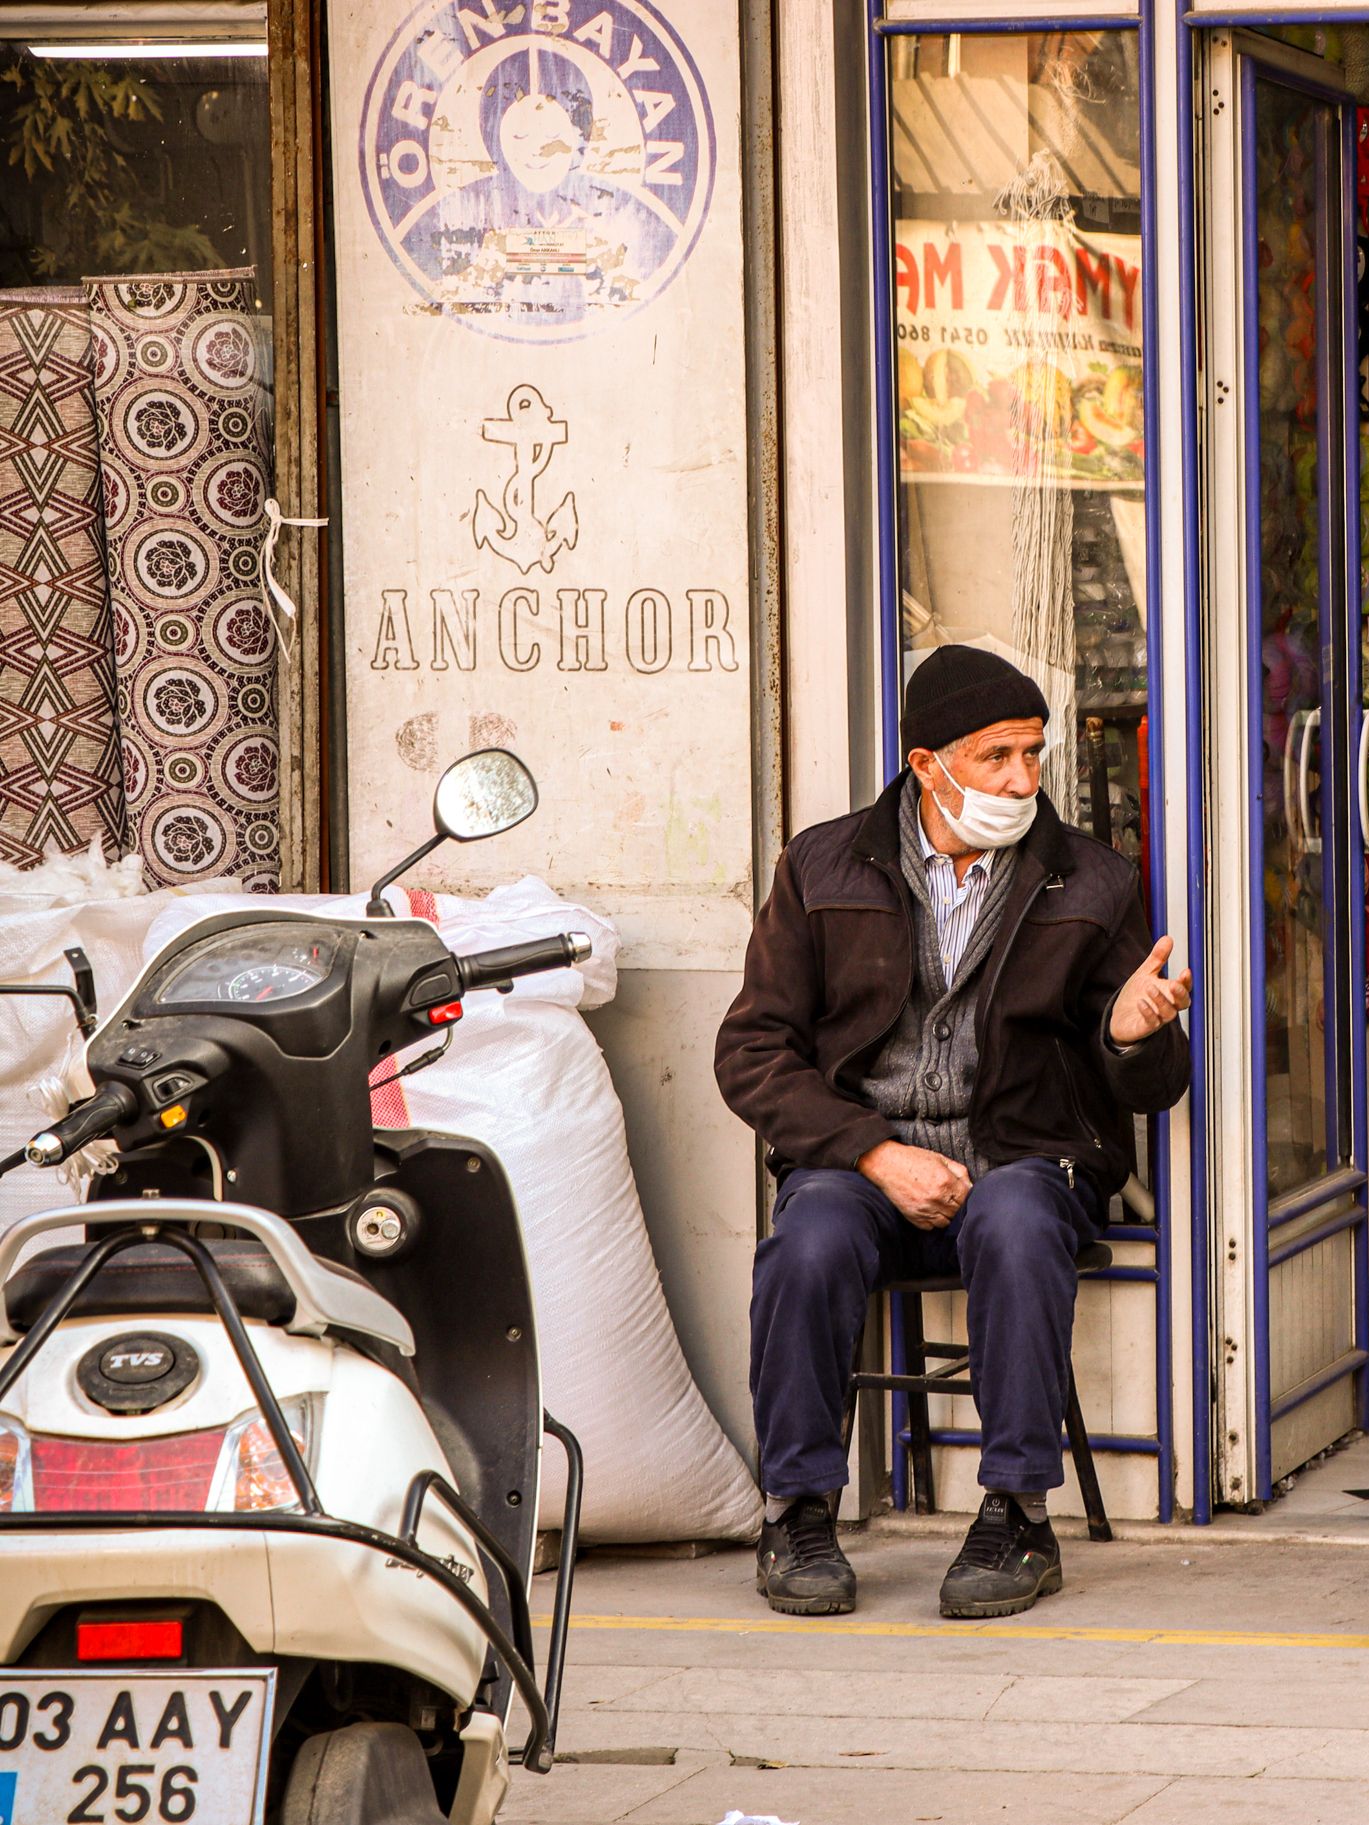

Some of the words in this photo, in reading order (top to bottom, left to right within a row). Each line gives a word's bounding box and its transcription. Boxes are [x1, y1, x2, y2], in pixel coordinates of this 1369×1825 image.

[380, 0, 507, 189] ÖREN
[531, 0, 686, 187] BAYAN
[370, 587, 740, 675] ANCHOR
[109, 1352, 164, 1369] TVS
[0, 1691, 75, 1751] 03
[96, 1690, 253, 1749] AAY
[67, 1764, 199, 1825] 256
